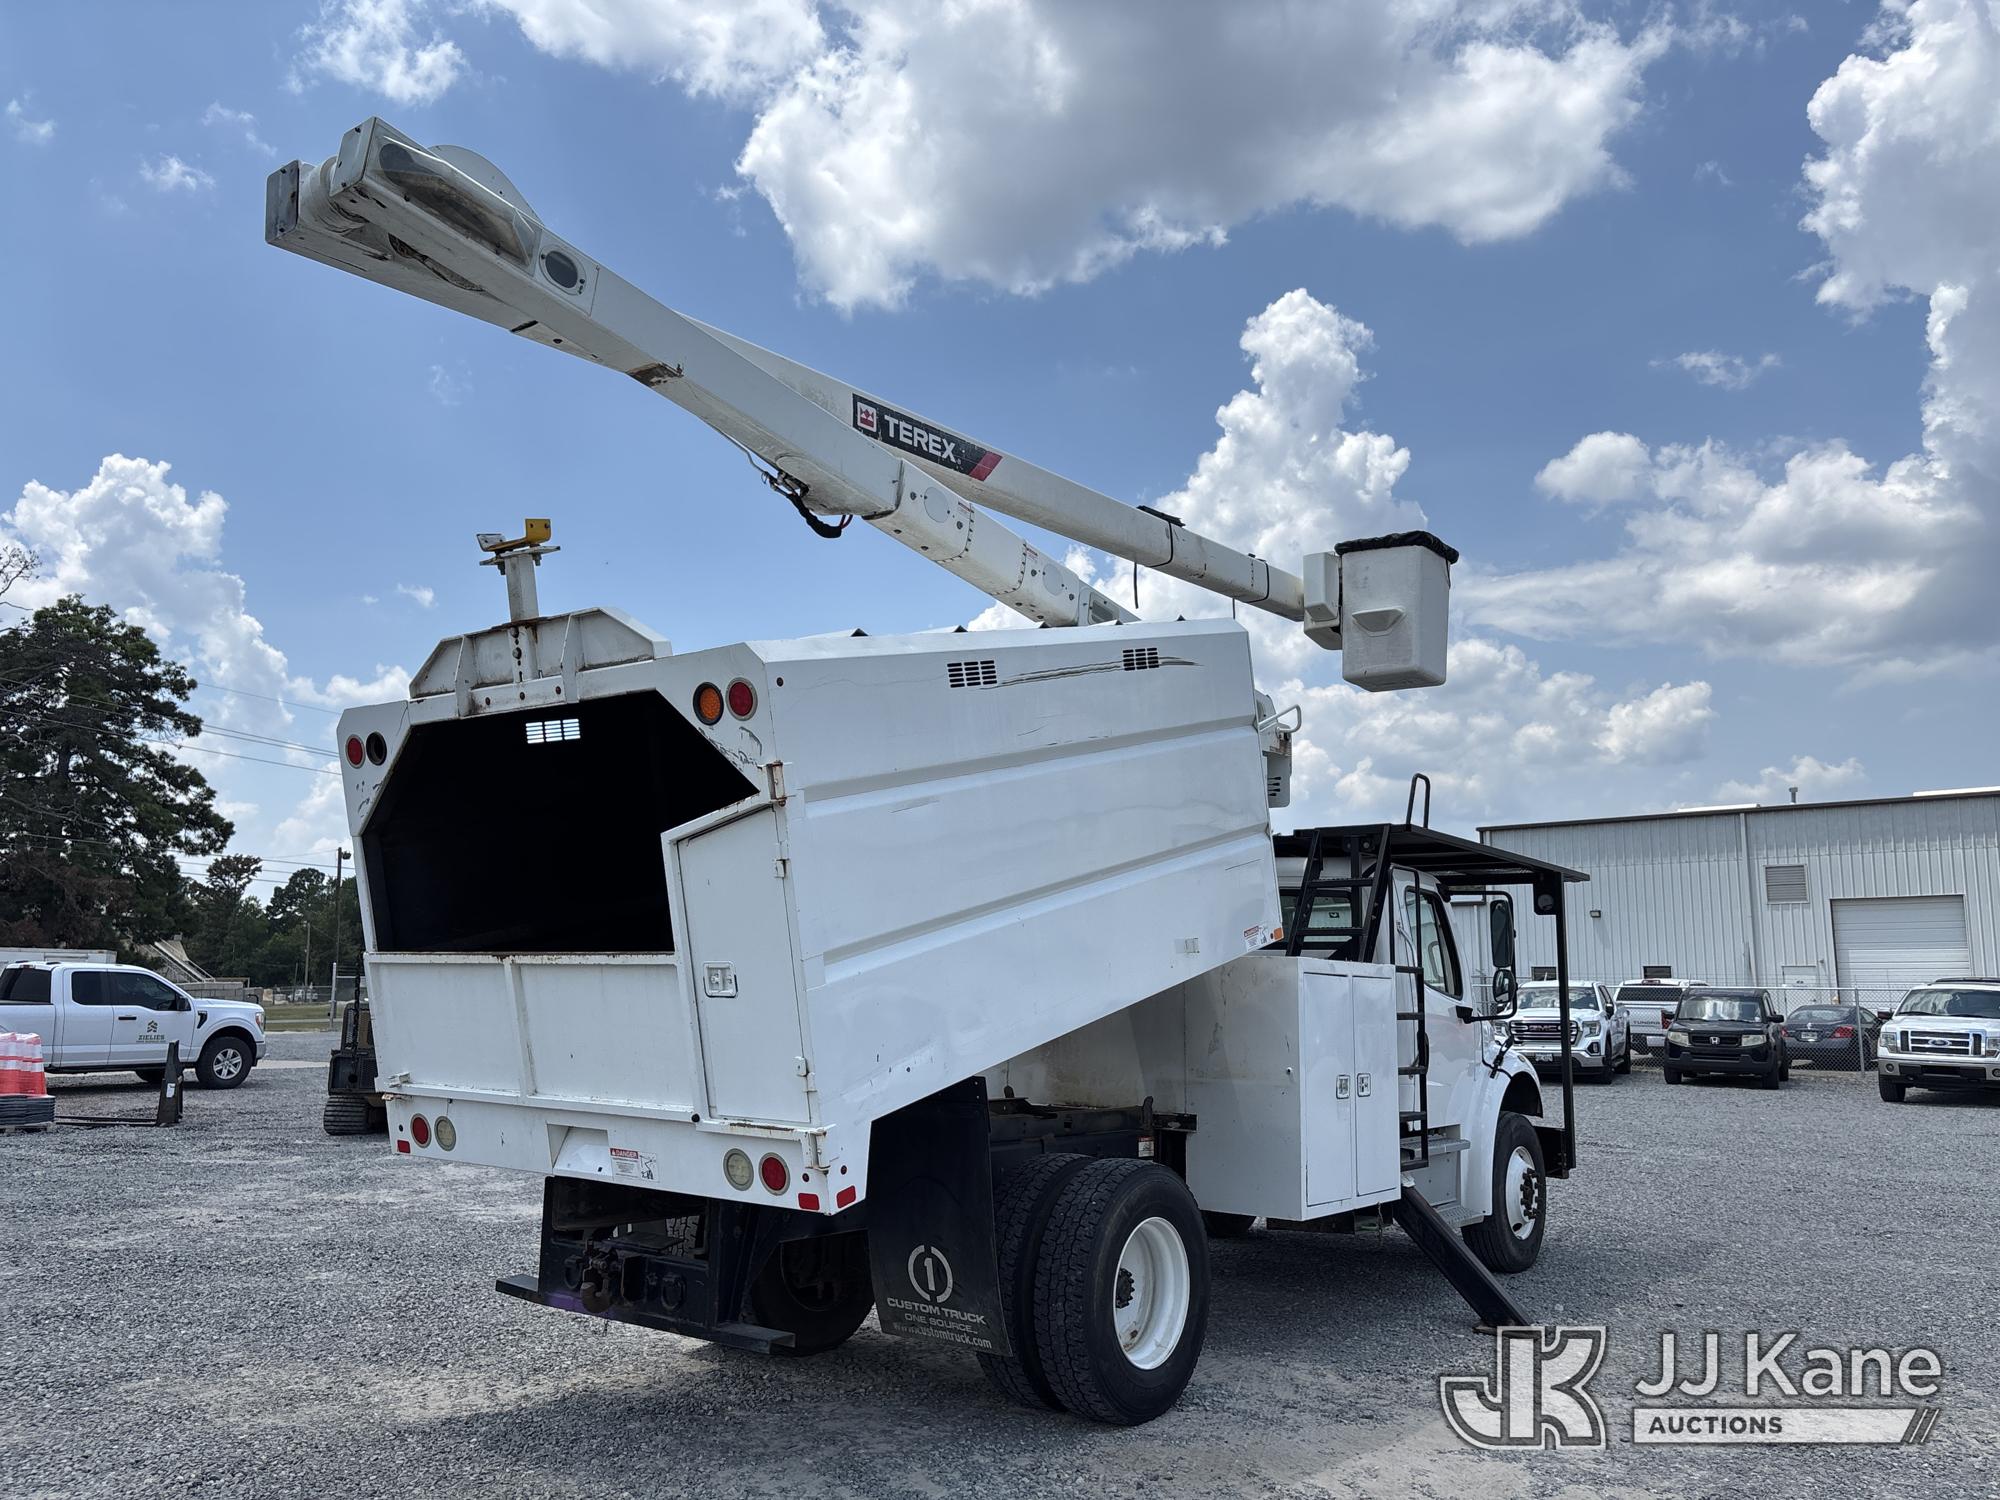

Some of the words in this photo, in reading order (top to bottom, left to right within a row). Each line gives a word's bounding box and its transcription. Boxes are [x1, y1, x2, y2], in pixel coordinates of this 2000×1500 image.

[884, 414, 956, 463] TEREX
[1529, 1024, 1558, 1032] GMC
[615, 1149, 638, 1159] DANGER
[887, 1297, 940, 1315] CUSTOM
[941, 1307, 987, 1325] TRUCK
[904, 1313, 928, 1324] ONE
[929, 1317, 973, 1332] SOURCE
